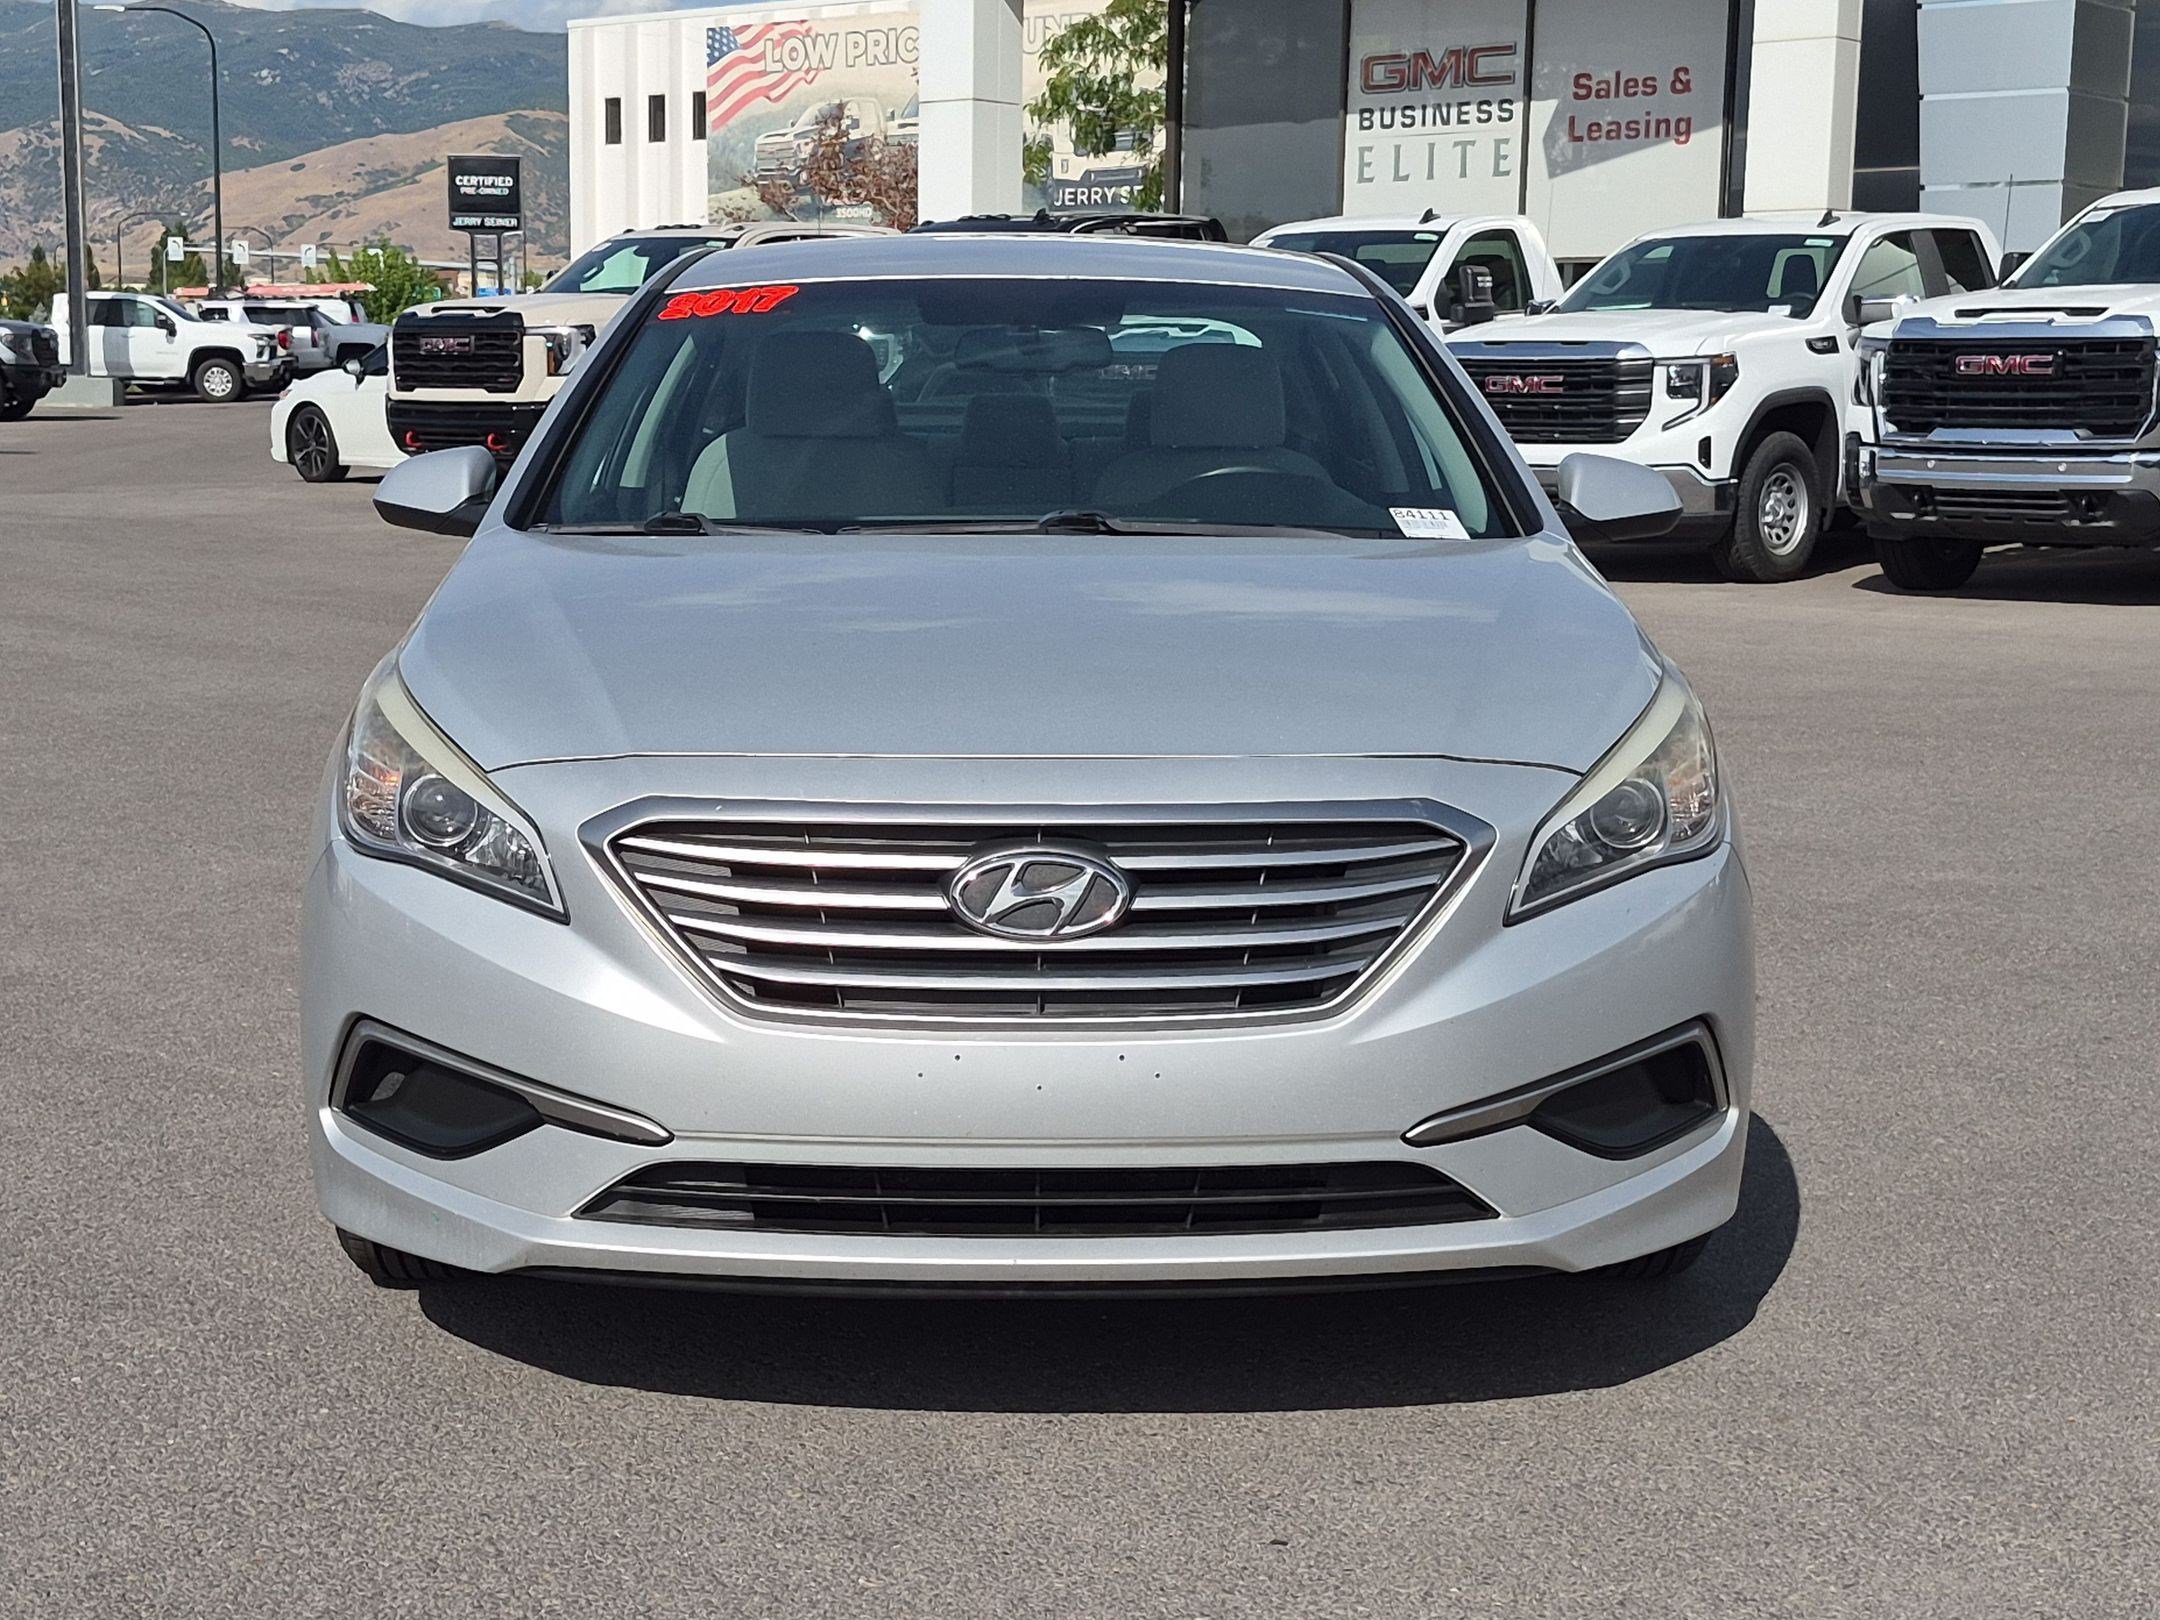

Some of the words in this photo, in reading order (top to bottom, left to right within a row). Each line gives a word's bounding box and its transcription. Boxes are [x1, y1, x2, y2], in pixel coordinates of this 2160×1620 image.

[763, 32, 839, 73] LOW
[1360, 42, 1517, 94] GMC
[1572, 70, 1658, 101] Sales
[1670, 66, 1692, 95] &
[1358, 98, 1514, 131] BUSINESS
[1567, 111, 1692, 145] Leasing
[1356, 138, 1512, 184] ELITE
[455, 175, 514, 187] CERTIFIED
[1053, 186, 1117, 206] JERRY
[453, 217, 482, 226] JERRY
[657, 285, 800, 321] 2017
[1955, 354, 2054, 375] GMC
[1485, 375, 1564, 394] GMC
